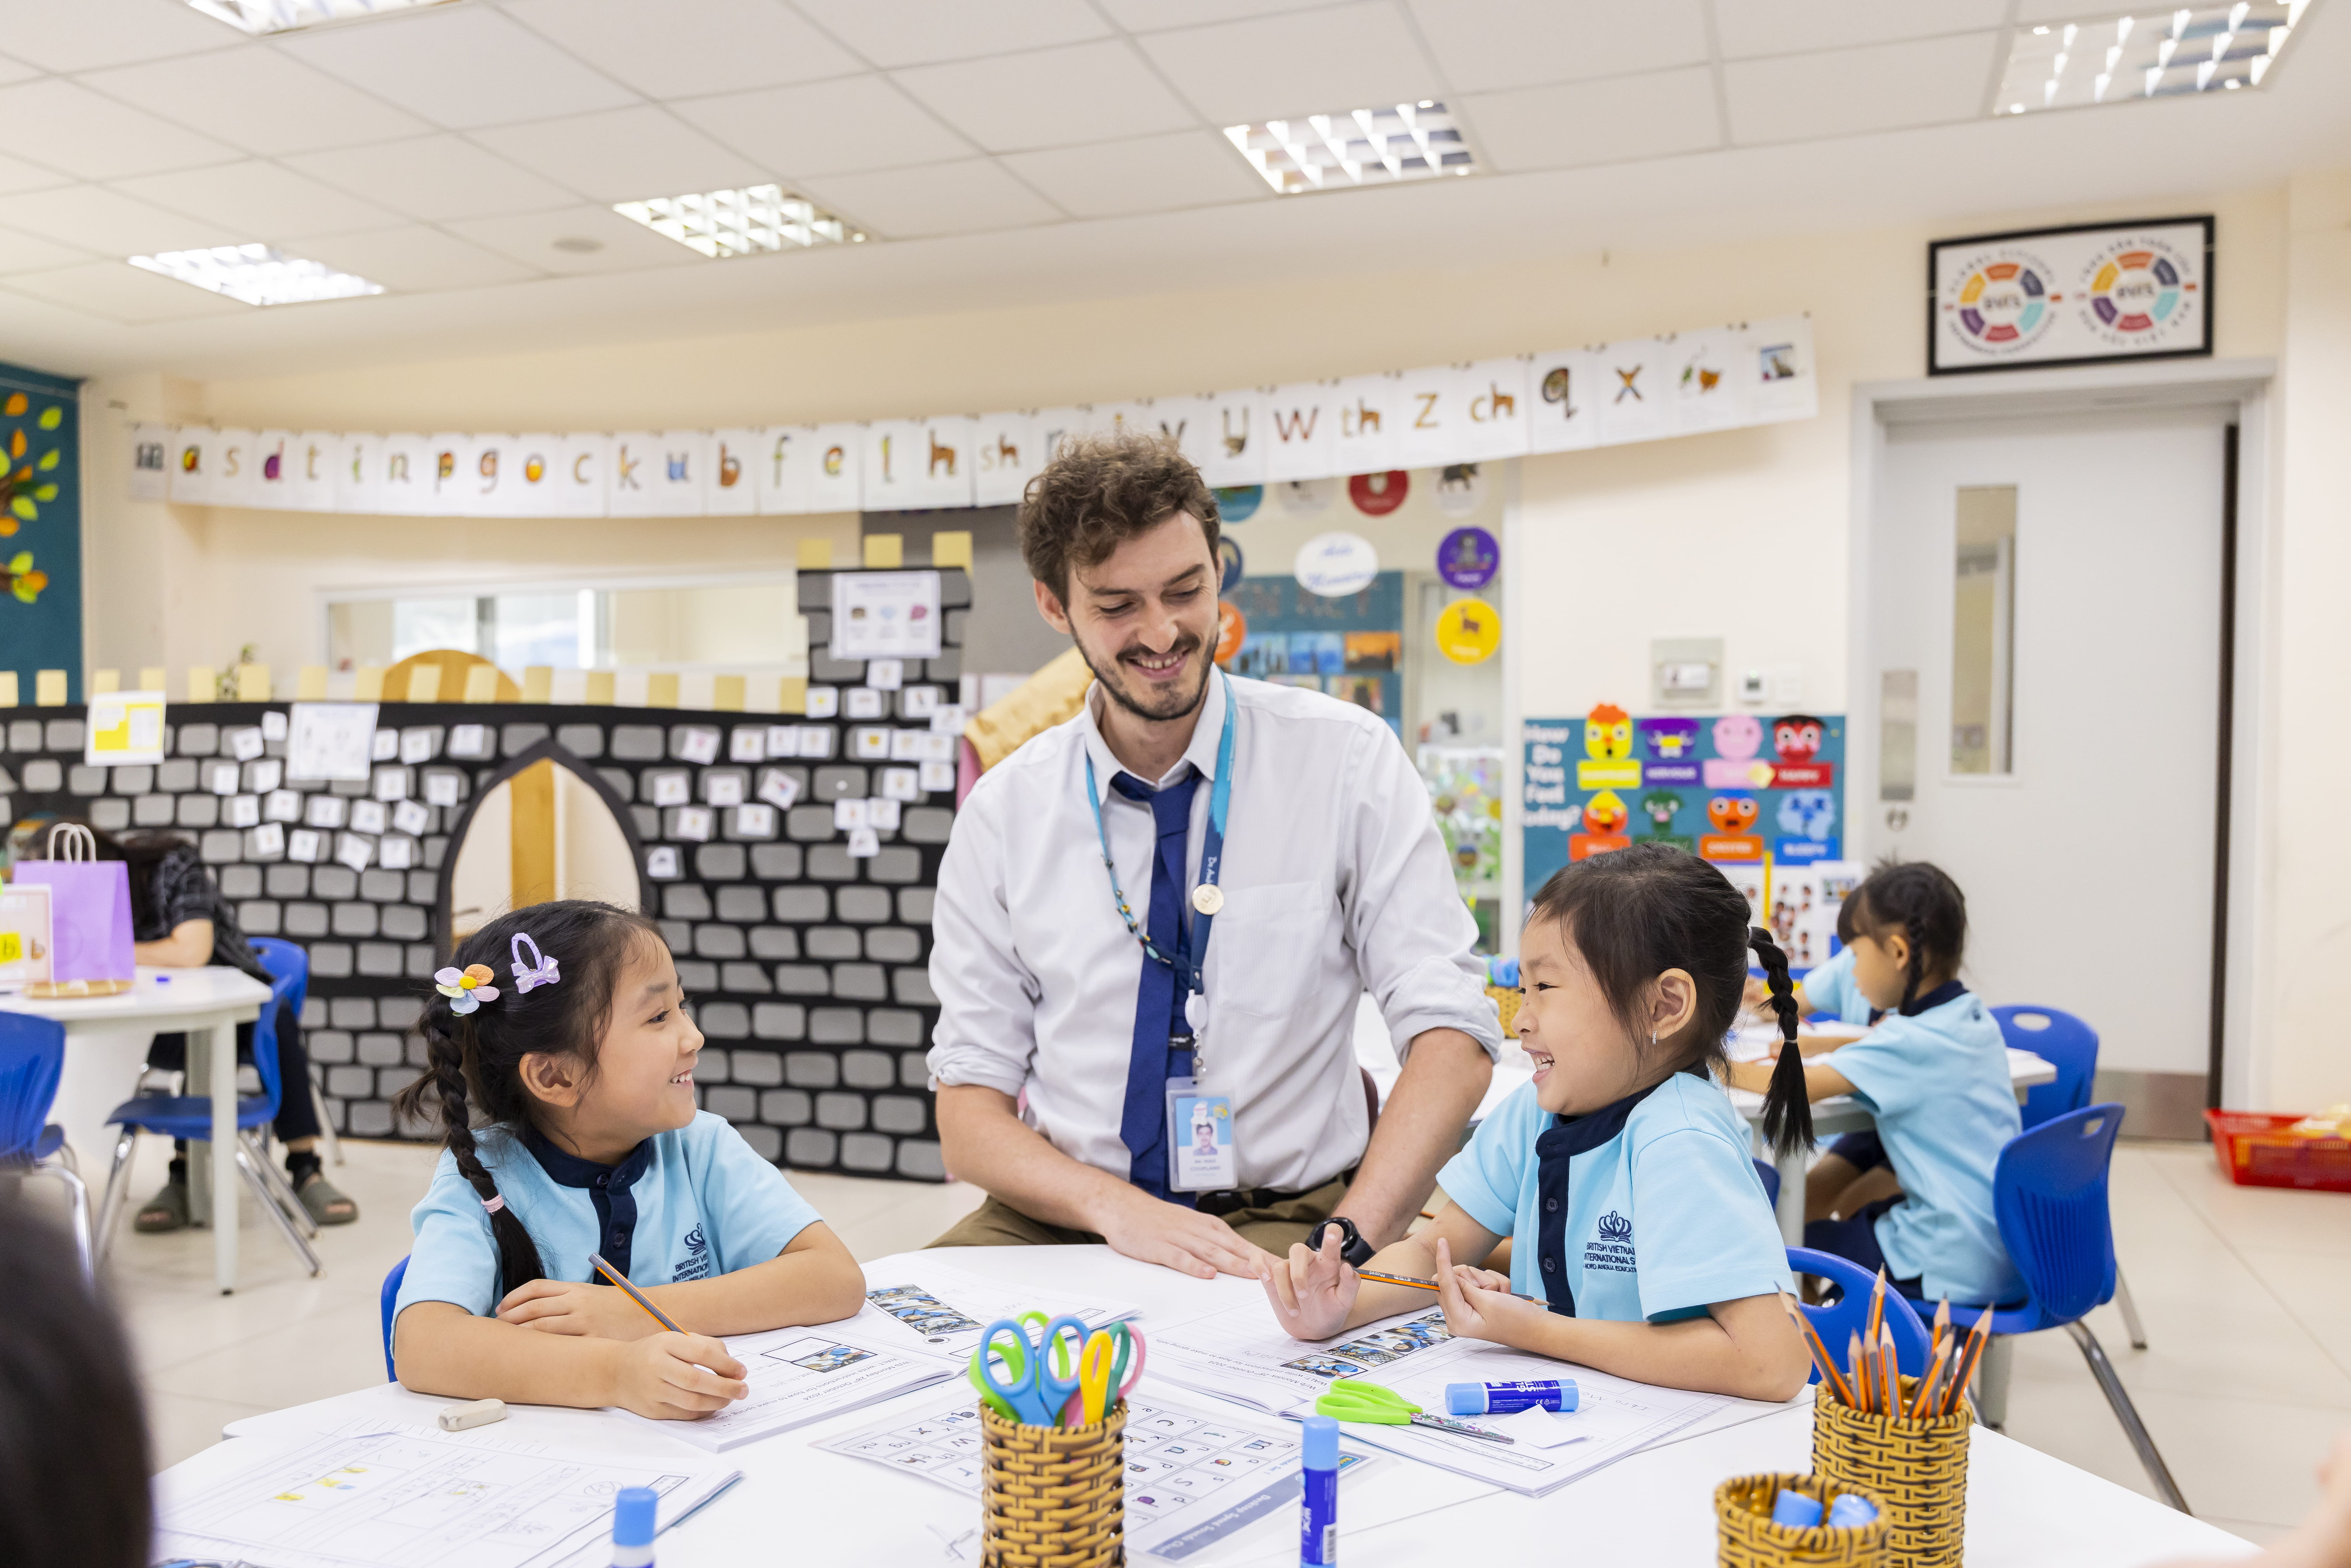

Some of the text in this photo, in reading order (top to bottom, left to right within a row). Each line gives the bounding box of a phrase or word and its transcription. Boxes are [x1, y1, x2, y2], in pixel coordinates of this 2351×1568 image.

[225, 447, 240, 476] s
[264, 439, 283, 482] d
[390, 452, 410, 484] n
[436, 451, 454, 492] p
[480, 449, 498, 492] g
[526, 454, 544, 483] o
[575, 453, 591, 484] c
[620, 444, 639, 489] k
[720, 441, 740, 486] b
[773, 436, 791, 487] f
[825, 445, 844, 475] e
[929, 430, 956, 476] h
[1342, 397, 1381, 436] th
[1469, 382, 1515, 422] ch
[1614, 364, 1644, 402] x
[30, 937, 46, 961] b
[1586, 1242, 1608, 1252] BRITISH
[675, 1257, 699, 1272] BRITISH
[877, 1357, 900, 1366] WALT:
[857, 1364, 876, 1373] write
[865, 1365, 896, 1377] Monday
[1226, 1365, 1254, 1374] October
[1243, 1364, 1284, 1373] instructions
[816, 1372, 857, 1389] instructions
[1269, 1374, 1300, 1384] Monday
[1304, 1377, 1327, 1386] WALT:
[823, 1382, 852, 1394] October
[788, 1391, 805, 1399] how
[803, 1392, 823, 1400] 2024
[757, 1399, 777, 1407] make
[730, 1406, 756, 1417] spring
[1243, 1439, 1274, 1450] m
